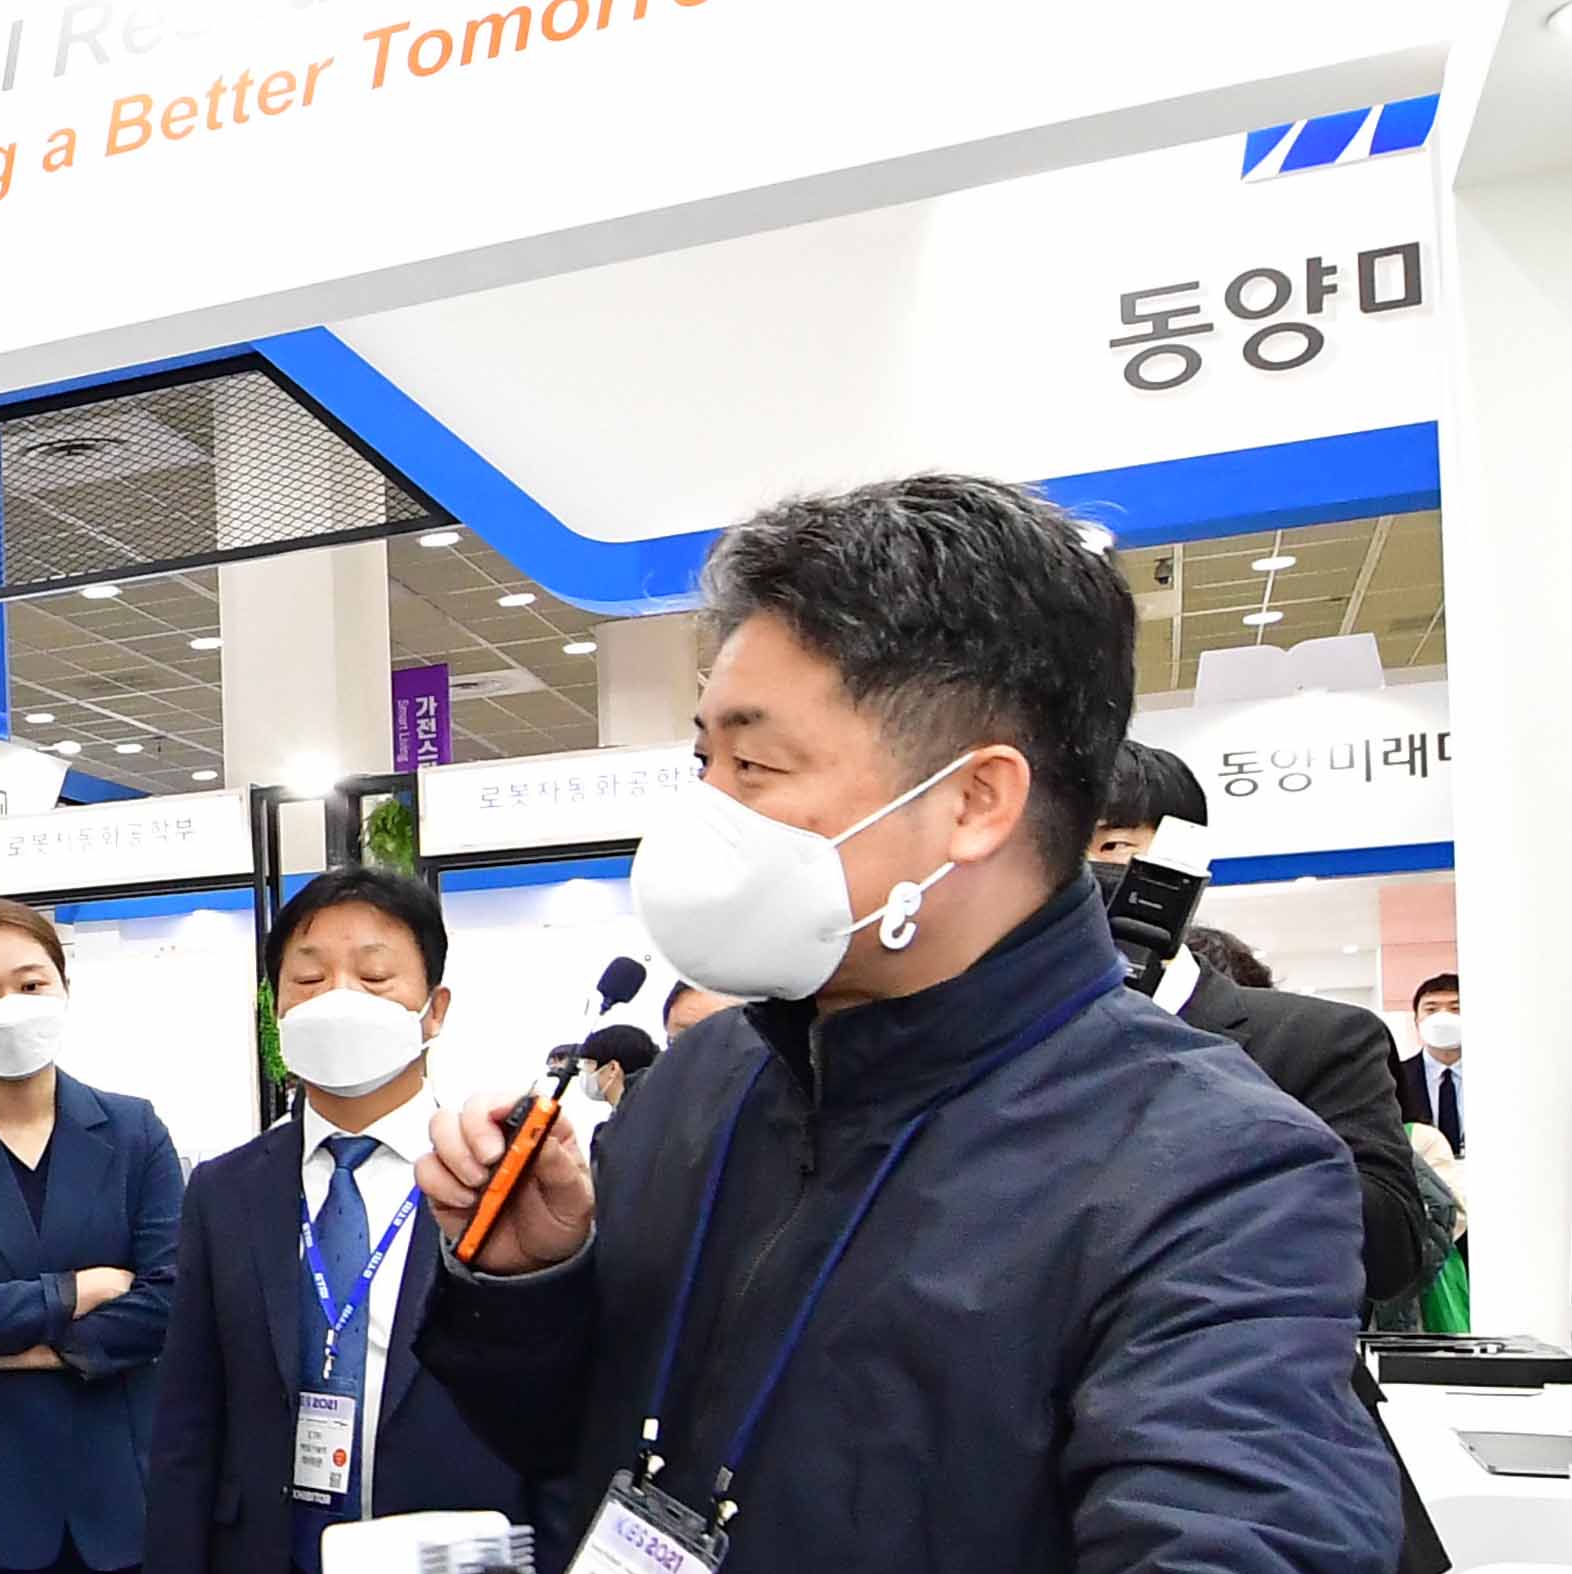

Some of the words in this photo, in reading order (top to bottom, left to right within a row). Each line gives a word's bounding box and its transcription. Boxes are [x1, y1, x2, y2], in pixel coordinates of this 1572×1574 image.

[42, 127, 77, 173] a
[105, 57, 334, 157] Better
[644, 1535, 685, 1574] 2021
